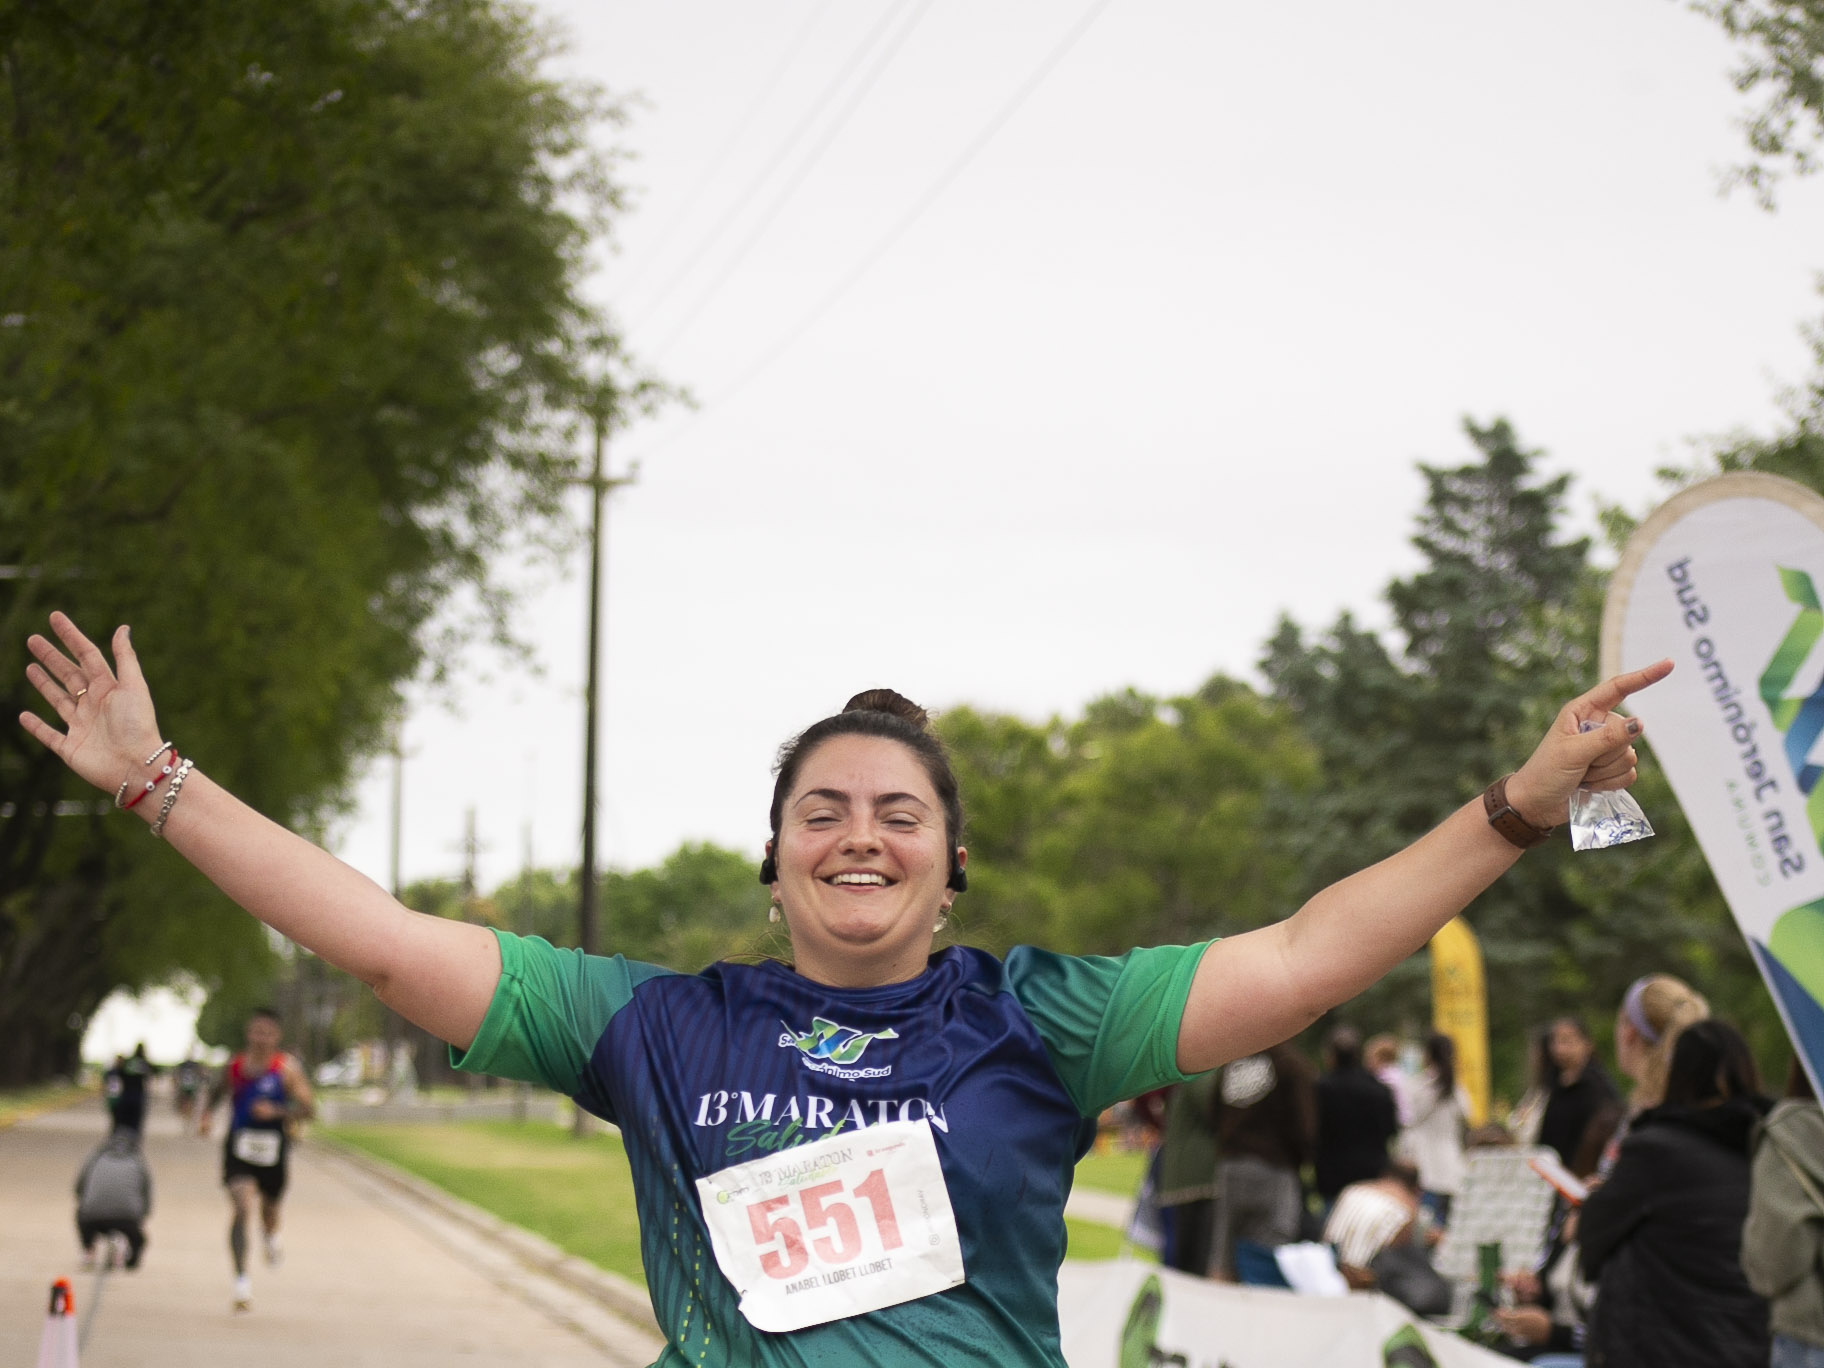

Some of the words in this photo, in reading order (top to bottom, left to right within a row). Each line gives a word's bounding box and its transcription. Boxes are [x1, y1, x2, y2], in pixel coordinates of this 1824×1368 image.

[862, 1066, 892, 1077] Sud
[746, 1169, 903, 1280] 551
[785, 1276, 821, 1296] ANABEL
[860, 1258, 894, 1277] LLOBET
